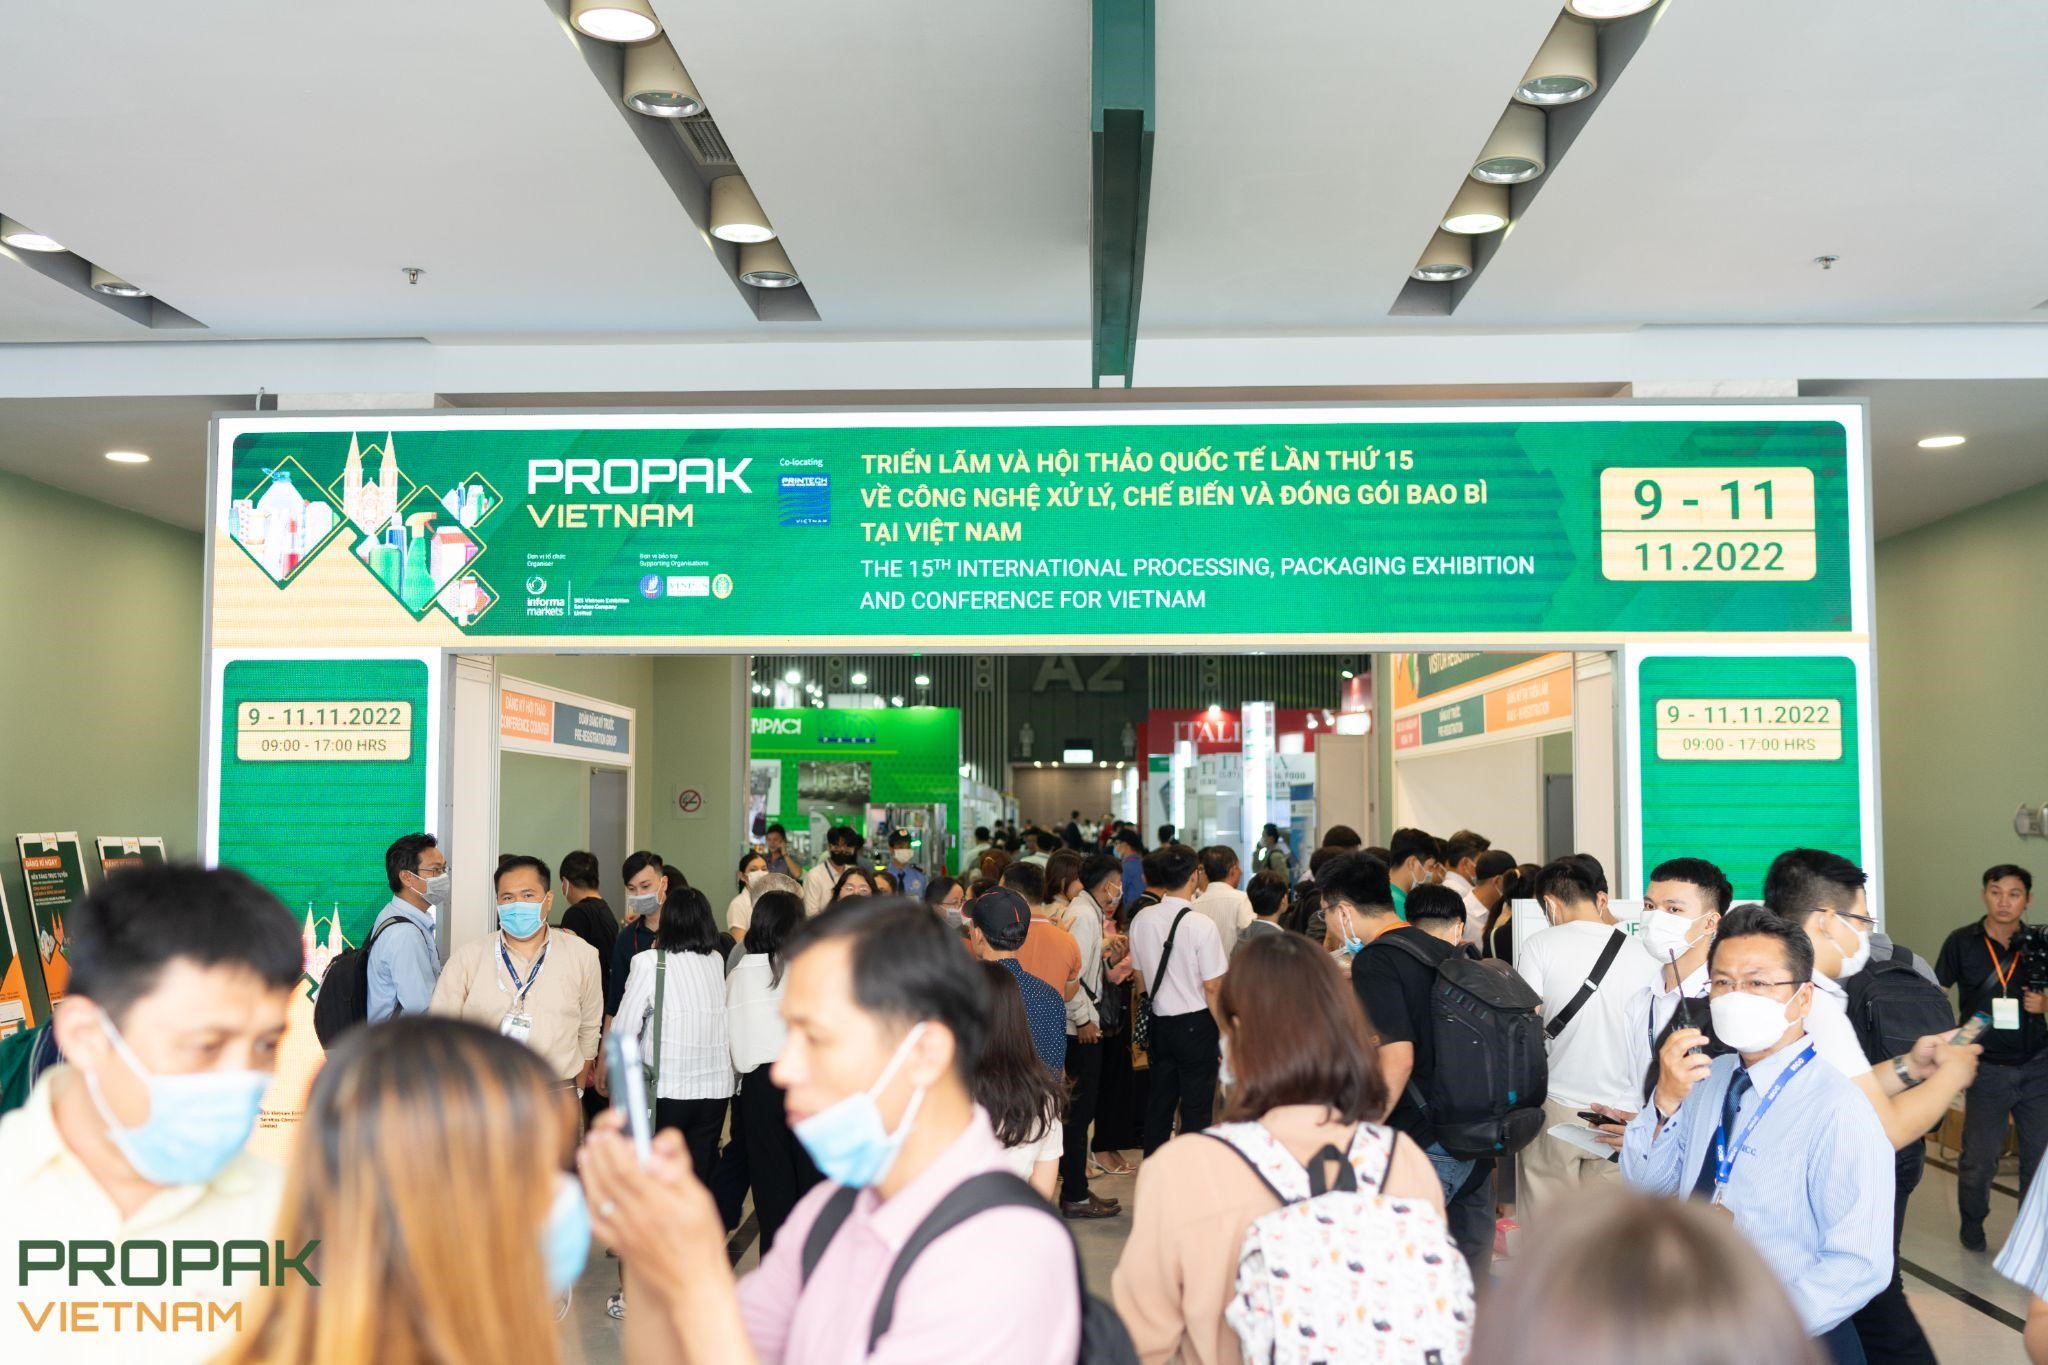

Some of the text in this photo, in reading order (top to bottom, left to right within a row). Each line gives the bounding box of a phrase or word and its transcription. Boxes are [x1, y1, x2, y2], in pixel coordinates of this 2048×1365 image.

[780, 458, 823, 467] Co-locating
[861, 446, 1414, 476] TRIỂN LÃM VÀ HỘI THẢO QUỐC TẾ LẦN THỨ 15
[528, 458, 753, 495] PROPAK
[861, 479, 1488, 511] VỀ CÔNG NGHỆ XỬ LÝ, CHẾ BIẾN VÀ ĐÓNG GÓI BAO BÌ
[1634, 479, 1662, 521] 9
[1720, 479, 1773, 520] 11
[527, 504, 694, 528] VIETNAM
[860, 517, 1022, 546] TẠI VIỆT NAM
[1635, 541, 1784, 571] 11.2022
[860, 559, 903, 578] THE
[957, 558, 1127, 578] INTERNATIONAL
[1134, 557, 1275, 579] PROCESSING,
[1282, 557, 1406, 576] PACKAGING
[1412, 556, 1535, 575] EXHIBITION
[527, 598, 564, 606] informa
[860, 589, 1206, 609] AND CONFERENCE FOR VIETNAM
[527, 606, 564, 616] markets
[248, 708, 260, 726] 9
[283, 707, 401, 726] 11.11.2022
[1667, 705, 1680, 723] 9
[1704, 706, 1830, 724] 11.11.2022
[261, 738, 301, 752] 09:00
[314, 738, 353, 752] 17:00
[356, 738, 387, 752] HRS
[1682, 737, 1725, 751] 09:00
[1739, 737, 1780, 751] 17:00
[1784, 737, 1816, 751] HRS
